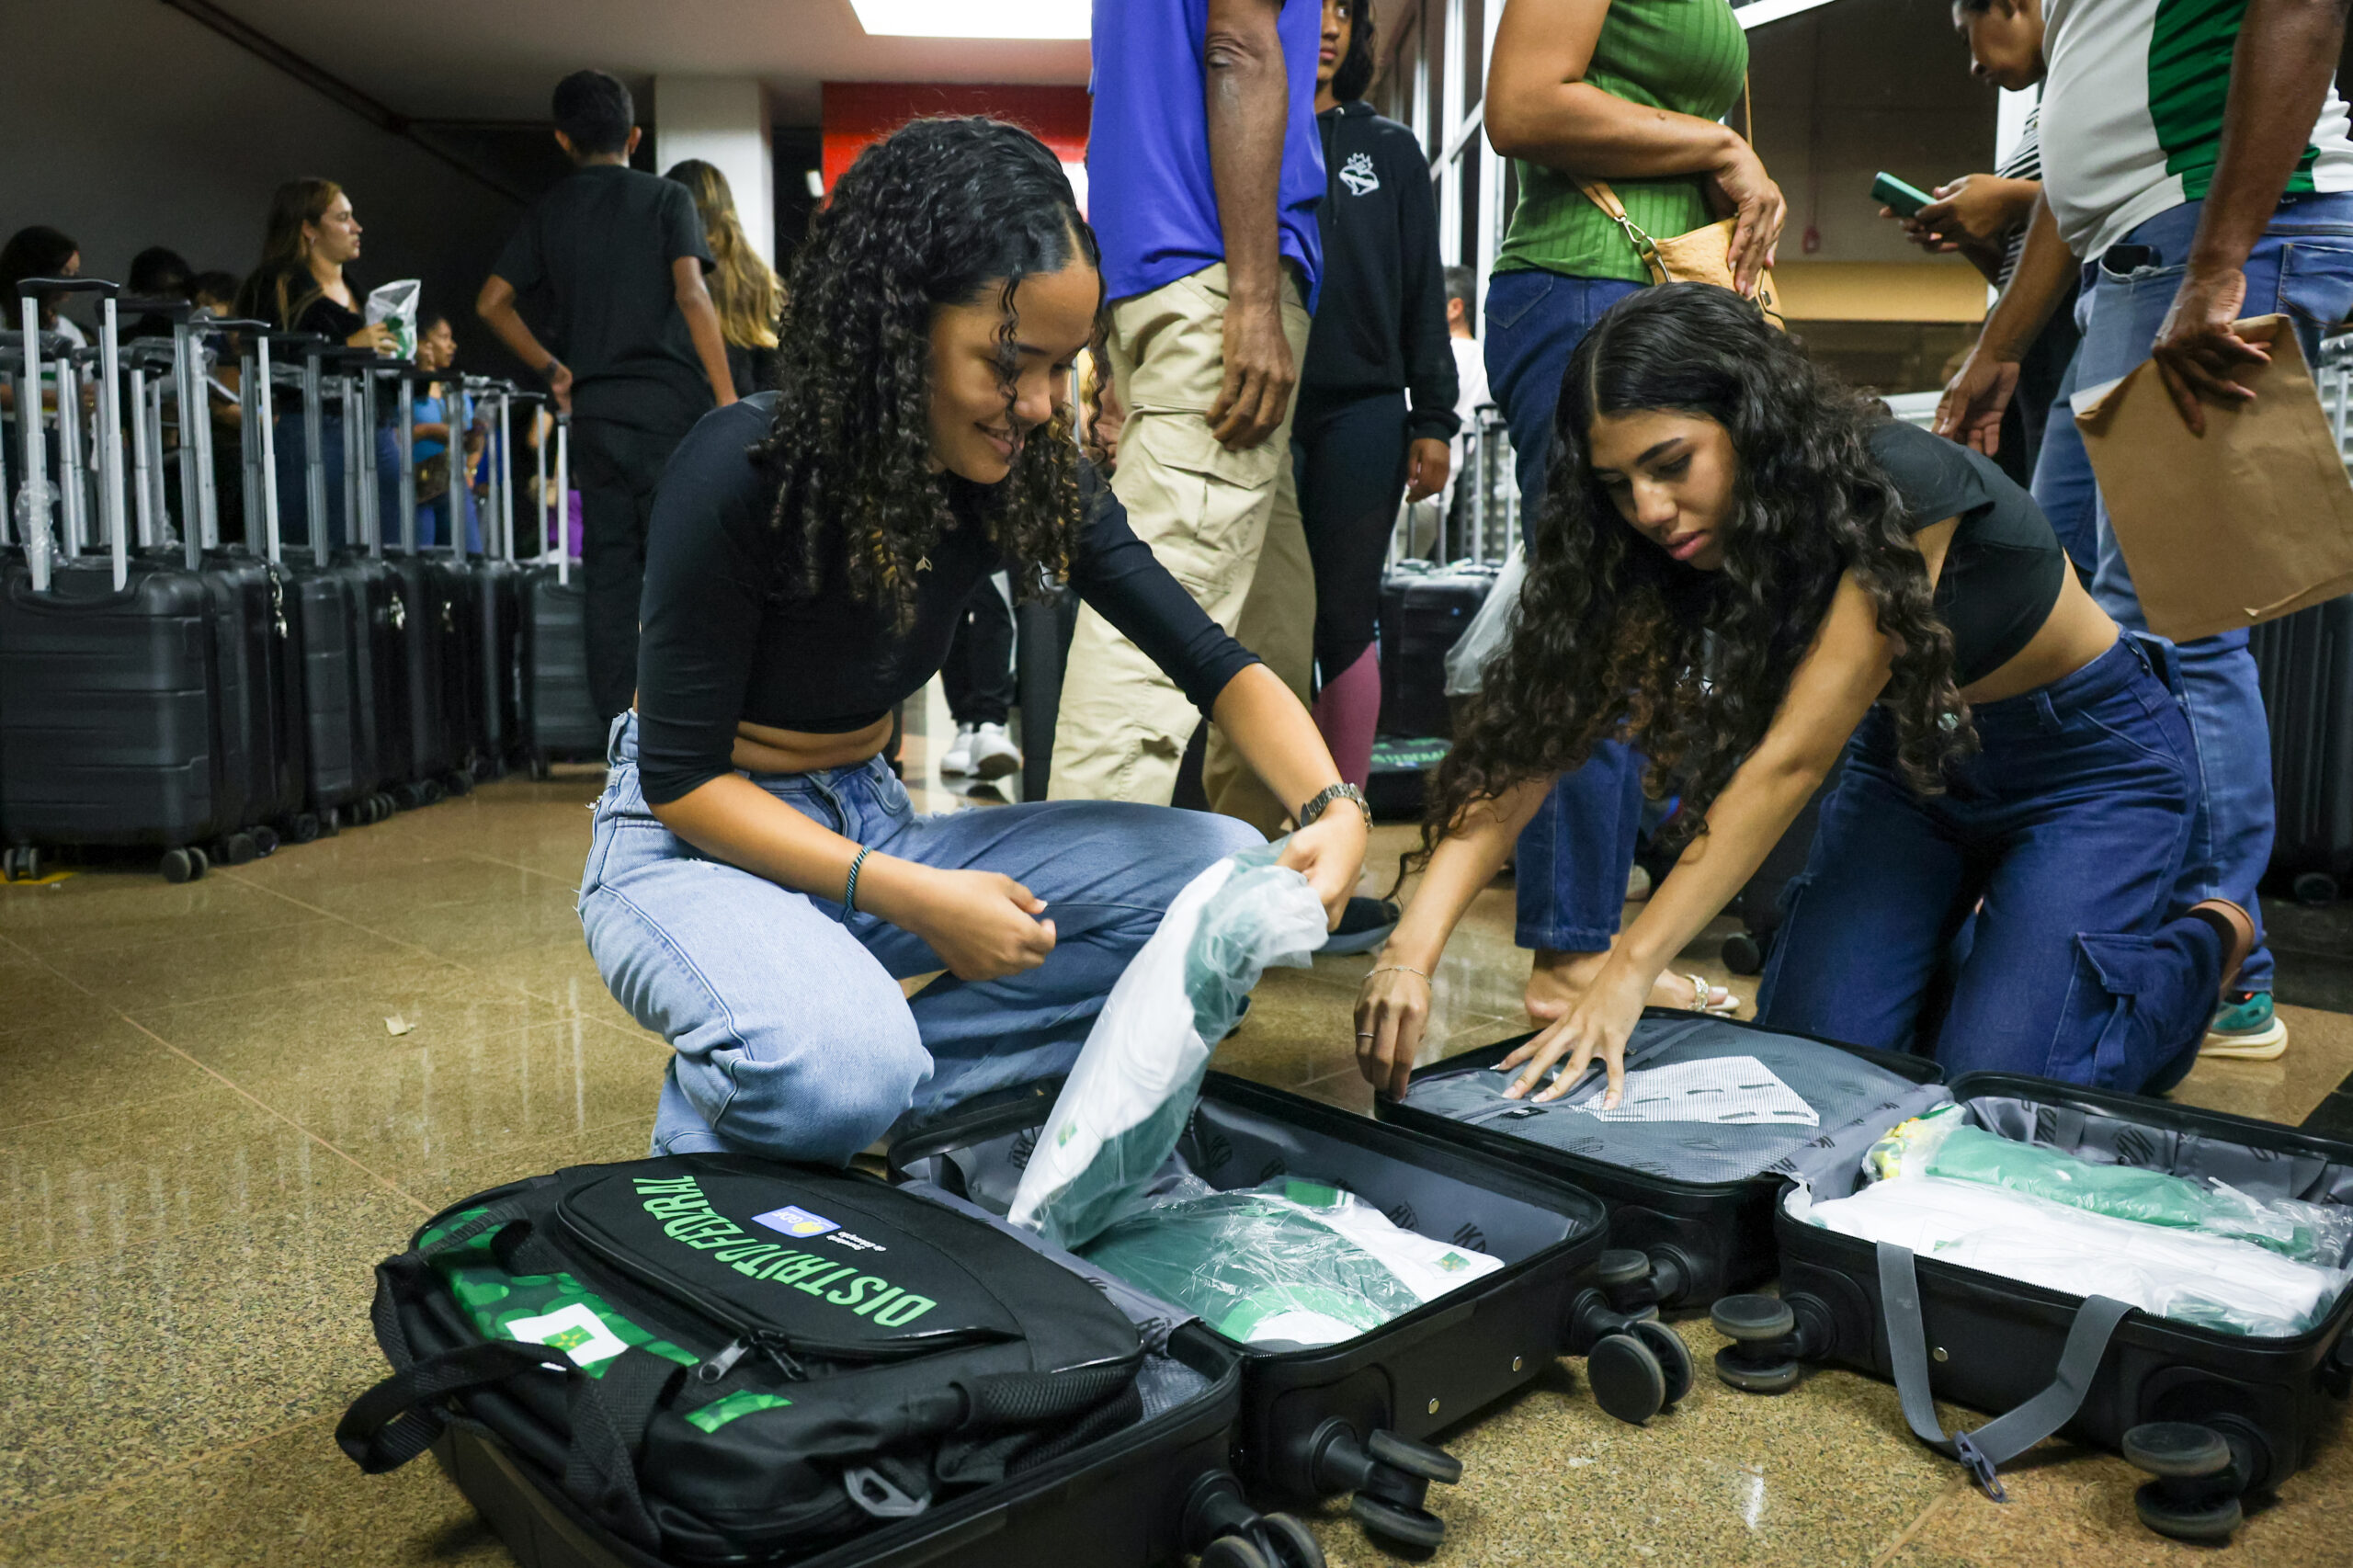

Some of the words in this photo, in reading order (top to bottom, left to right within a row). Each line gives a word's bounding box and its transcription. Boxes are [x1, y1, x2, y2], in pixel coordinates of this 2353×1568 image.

[632, 1175, 758, 1250] FEDERAL
[771, 1210, 804, 1224] GDF
[714, 1244, 938, 1327] DISTRITO
